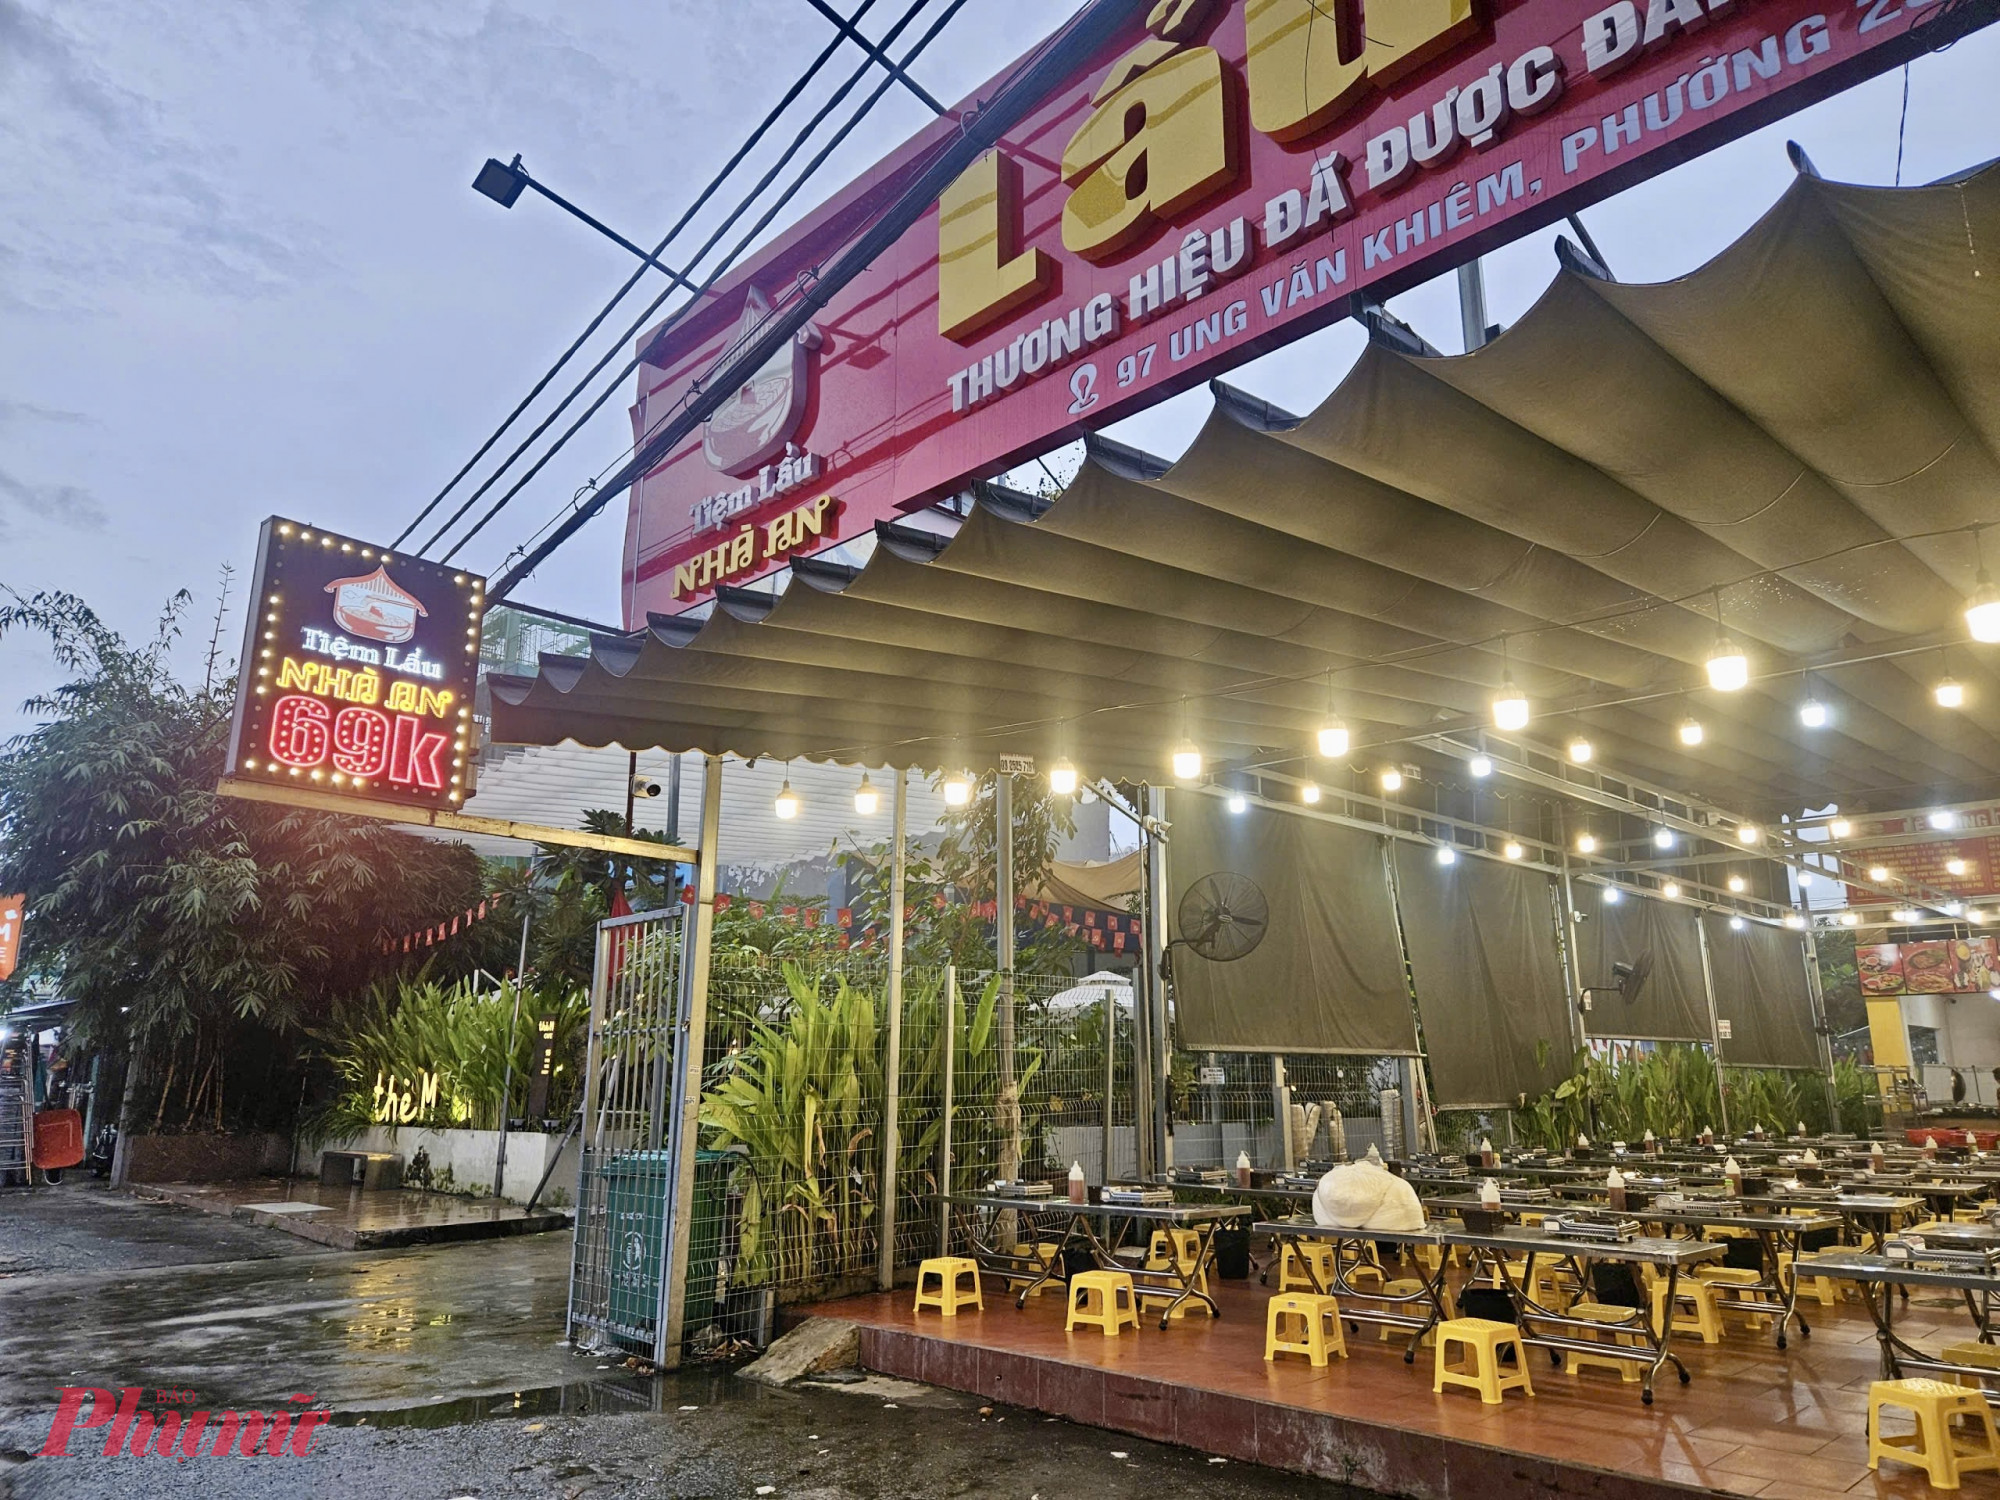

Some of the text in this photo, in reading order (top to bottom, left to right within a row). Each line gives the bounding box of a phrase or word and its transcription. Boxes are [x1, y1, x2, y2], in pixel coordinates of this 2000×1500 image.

[947, 300, 1116, 413] THƯƠNG
[1129, 216, 1246, 321] HIỆU
[1264, 150, 1349, 248] ĐÃ
[1365, 45, 1557, 190] ĐƯỢC
[1116, 343, 1158, 388] 97
[1168, 300, 1249, 361] UNG
[1259, 248, 1347, 318] VĂN
[1362, 160, 1543, 271] KHIÊM,
[1561, 14, 1831, 175] PHƯỜNG
[689, 441, 821, 535] Tiệm Lẩu
[670, 494, 832, 600] NHÀ AN
[275, 656, 454, 719] NHÀ AN
[301, 626, 443, 680] Tiệm Lẩu
